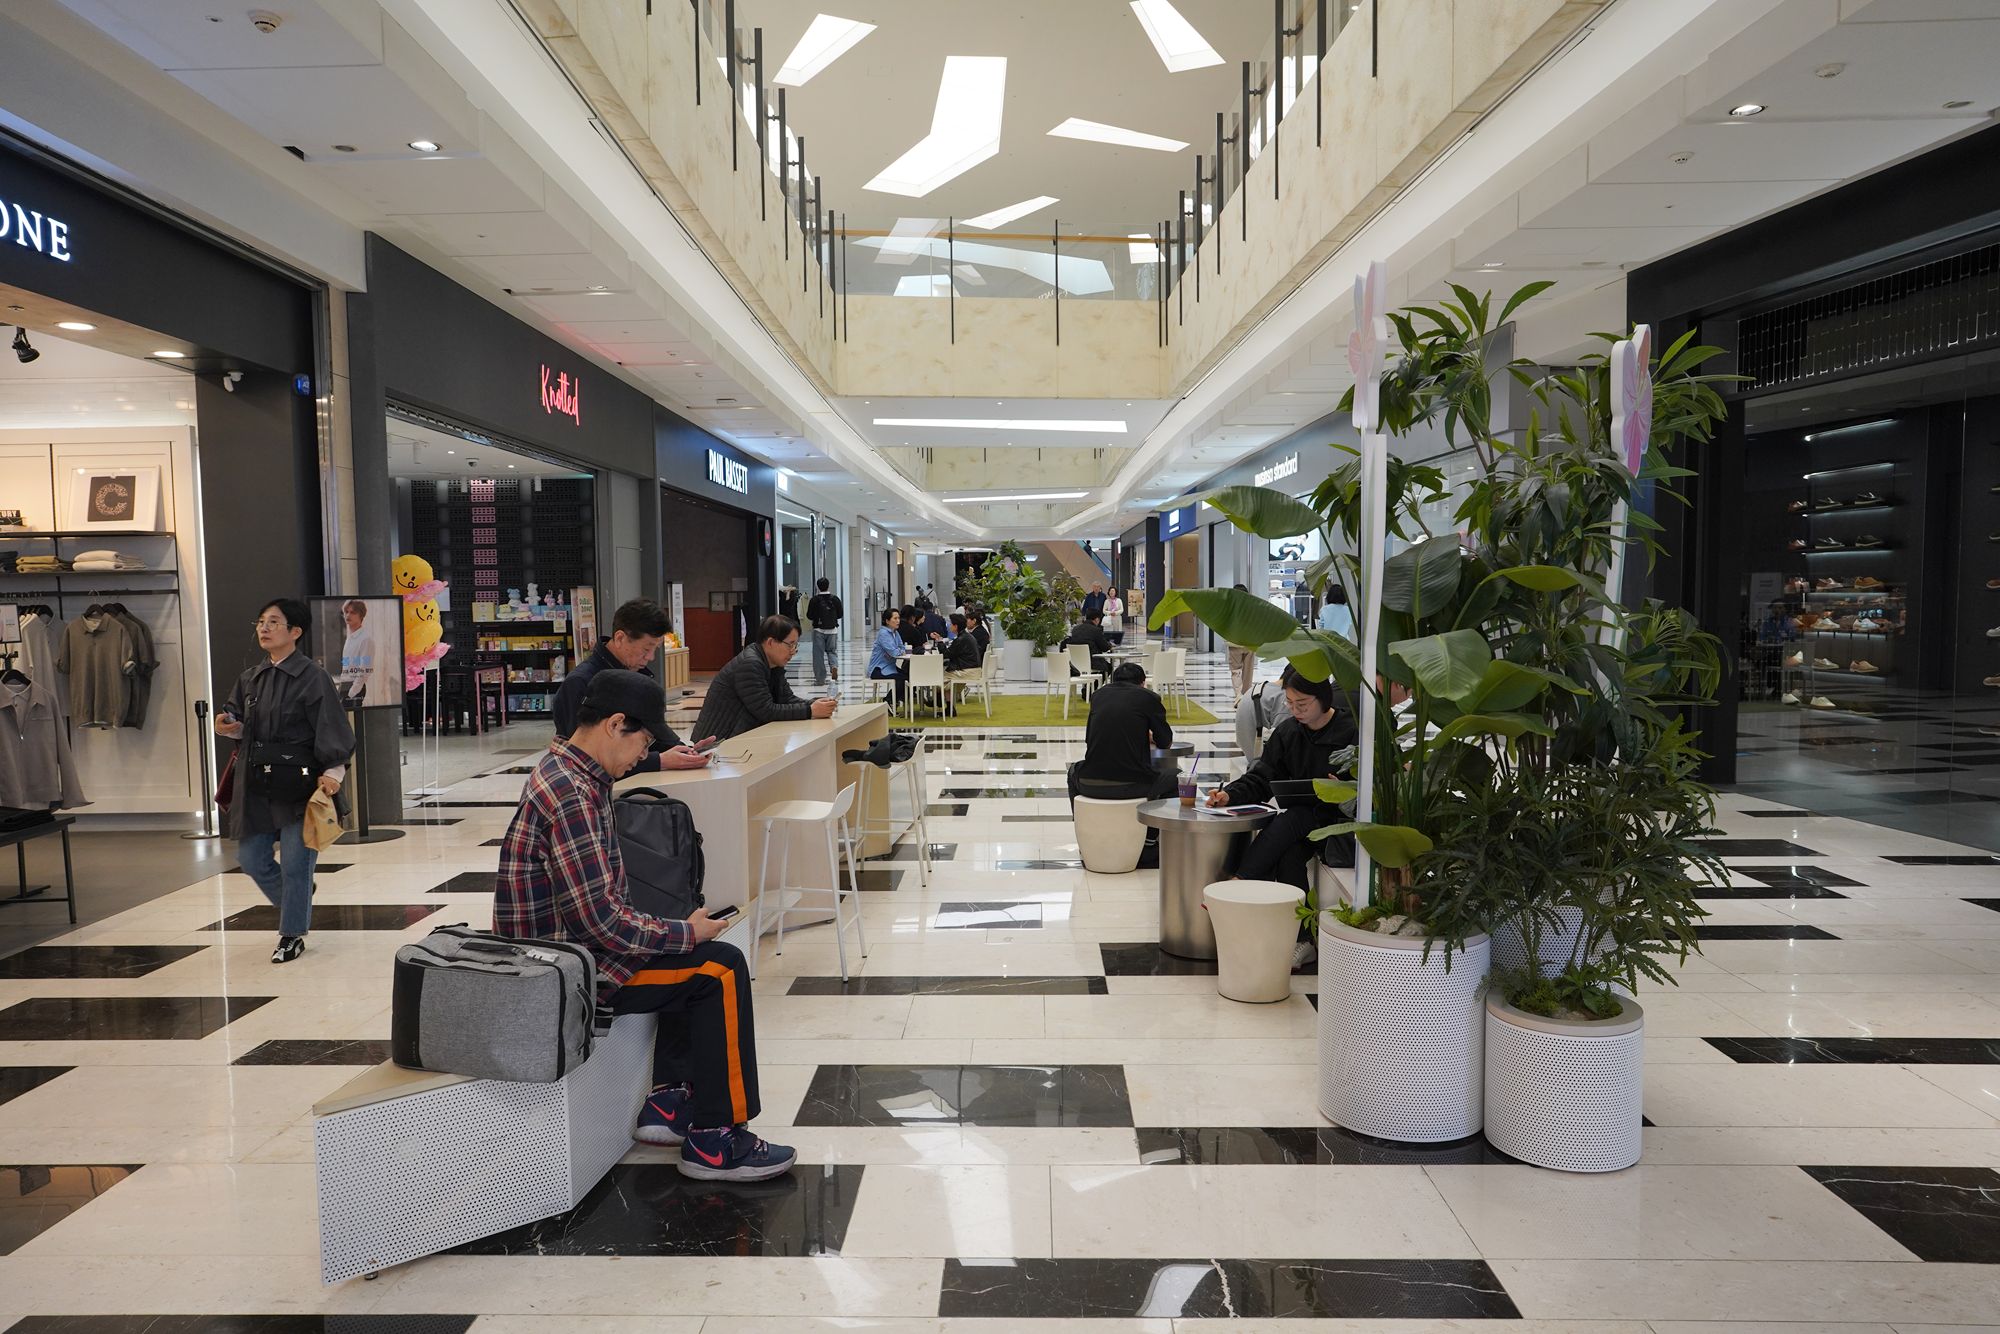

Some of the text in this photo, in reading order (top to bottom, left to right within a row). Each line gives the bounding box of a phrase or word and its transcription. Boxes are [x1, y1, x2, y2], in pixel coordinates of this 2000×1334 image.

[541, 364, 580, 426] Knotted
[708, 448, 726, 486] PAUL
[724, 457, 748, 495] BASSETT
[1273, 451, 1298, 482] standard
[0, 510, 17, 518] URY
